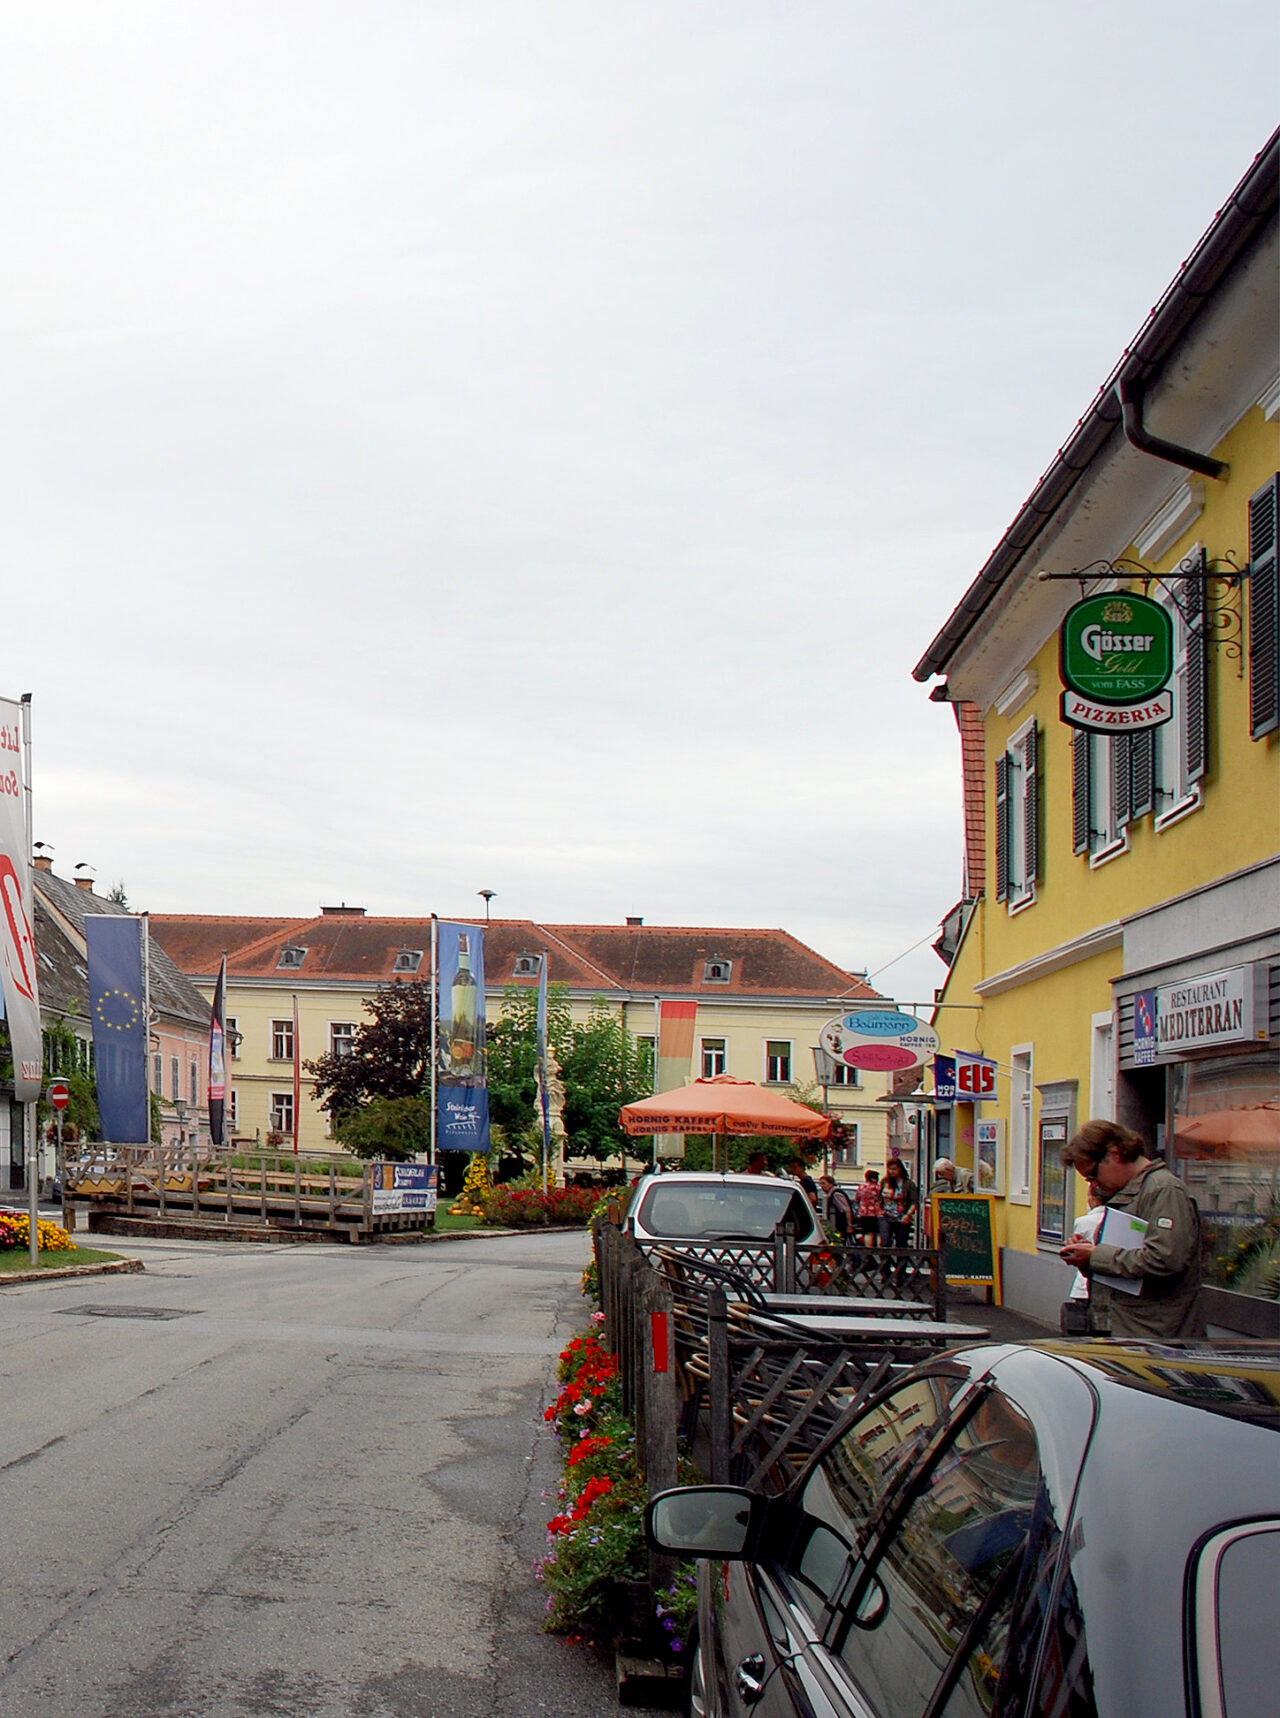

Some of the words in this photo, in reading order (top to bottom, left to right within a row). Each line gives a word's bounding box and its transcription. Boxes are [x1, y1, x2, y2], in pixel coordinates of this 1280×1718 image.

[1081, 624, 1155, 661] Gösser
[1096, 654, 1143, 674] Gold
[1091, 680, 1113, 689] vom
[1116, 679, 1146, 689] FASS
[1071, 702, 1167, 724] PIZZERIA
[1171, 980, 1227, 1009] RESTAURANT
[849, 1018, 910, 1030] Baumann
[1160, 998, 1242, 1043] MEDITERRAN
[959, 1064, 994, 1093] EIS
[629, 1115, 670, 1124] HORNIG
[675, 1115, 717, 1125] KAFFEE
[633, 1125, 668, 1133] HORNIG
